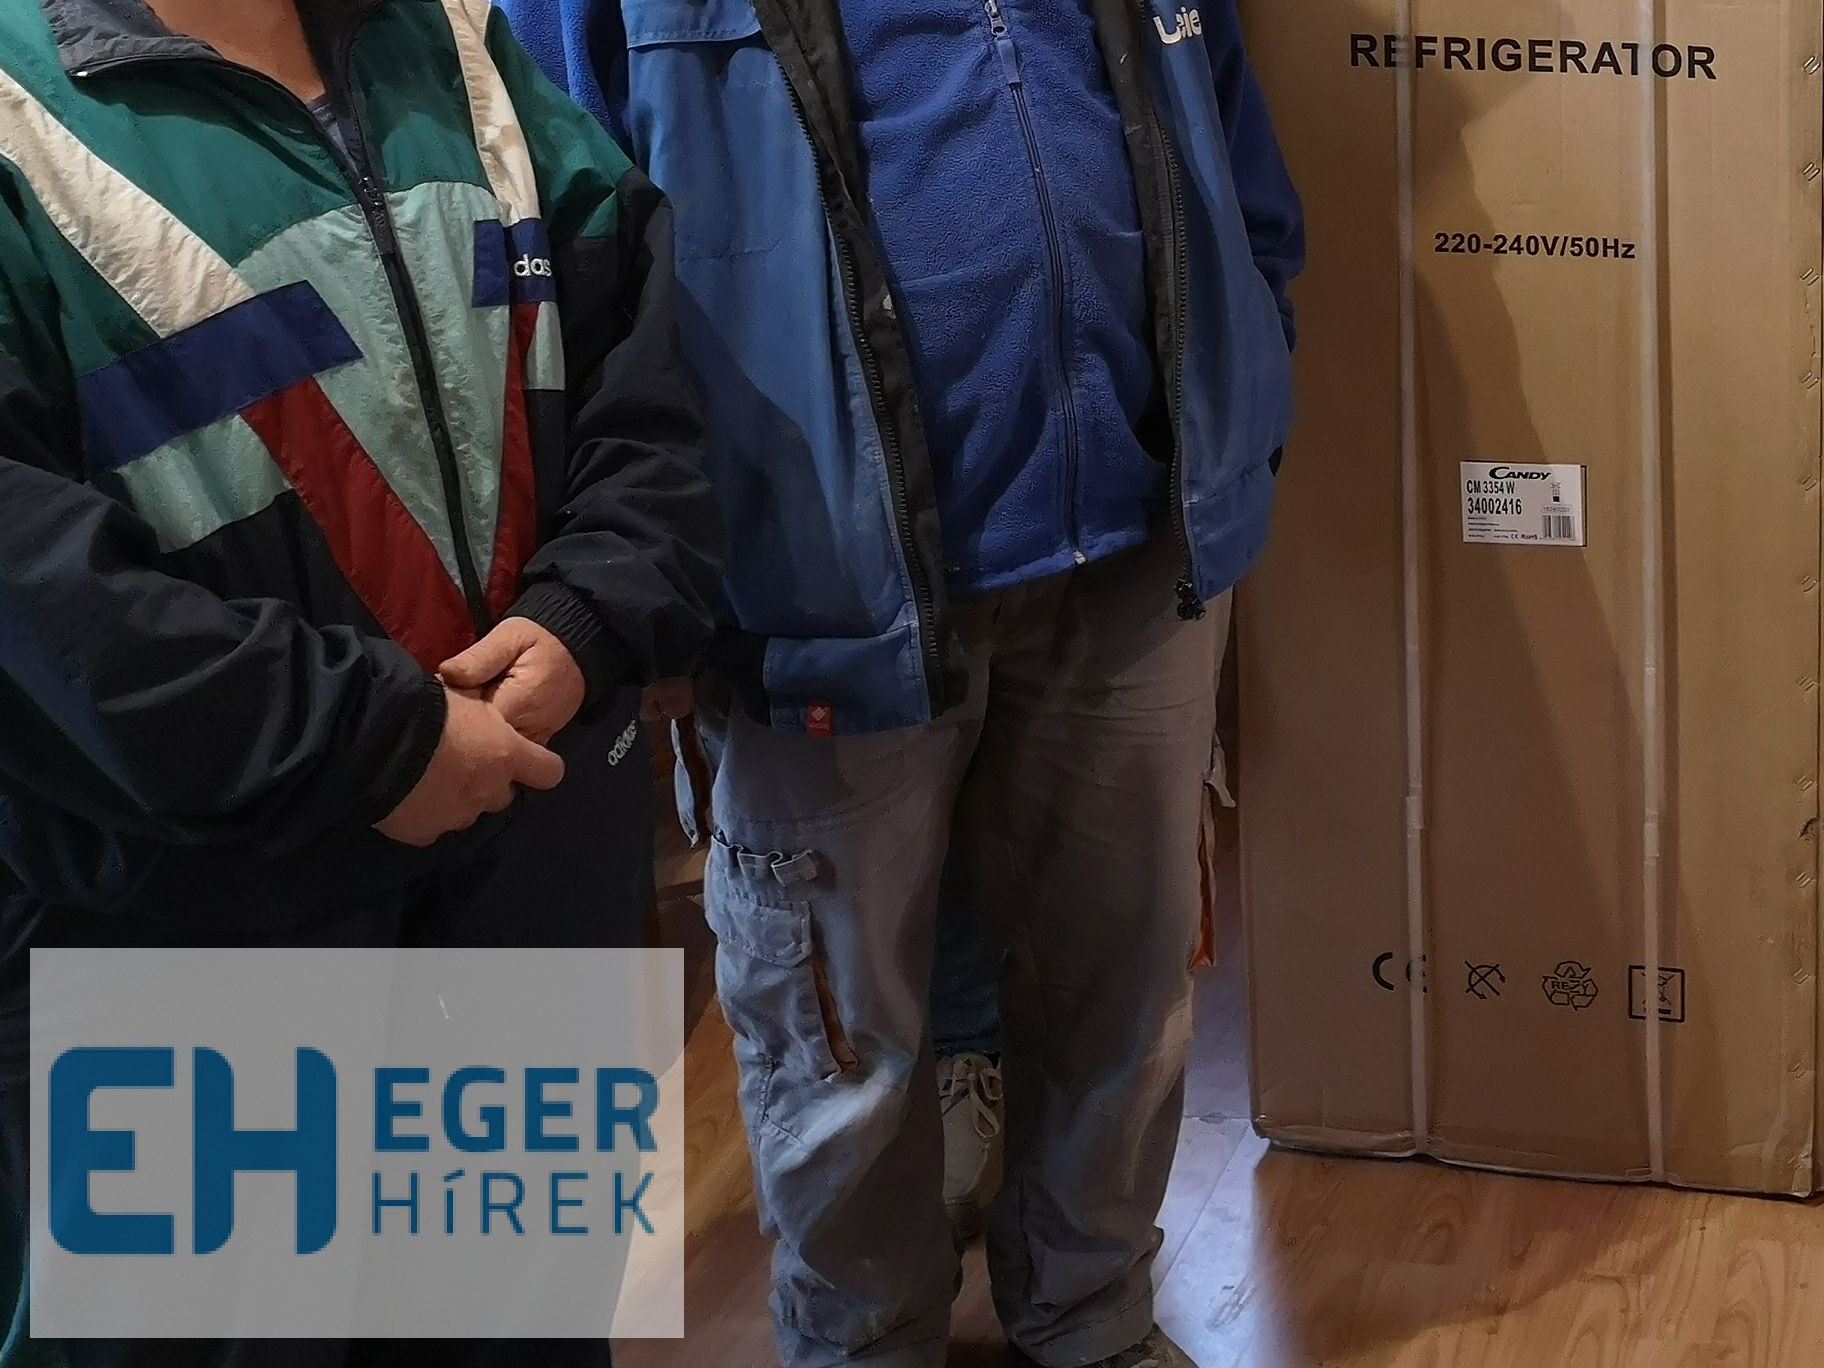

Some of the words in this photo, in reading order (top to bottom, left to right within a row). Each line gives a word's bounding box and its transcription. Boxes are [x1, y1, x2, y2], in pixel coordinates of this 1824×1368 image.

[1349, 33, 1717, 80] REFRIGERATOR
[1434, 232, 1636, 259] 220-240V/50Hz
[1488, 466, 1551, 480] CANDY
[1466, 480, 1480, 494] CM
[1483, 480, 1504, 494] 3354
[1506, 481, 1515, 494] W
[1467, 497, 1522, 515] 34002416
